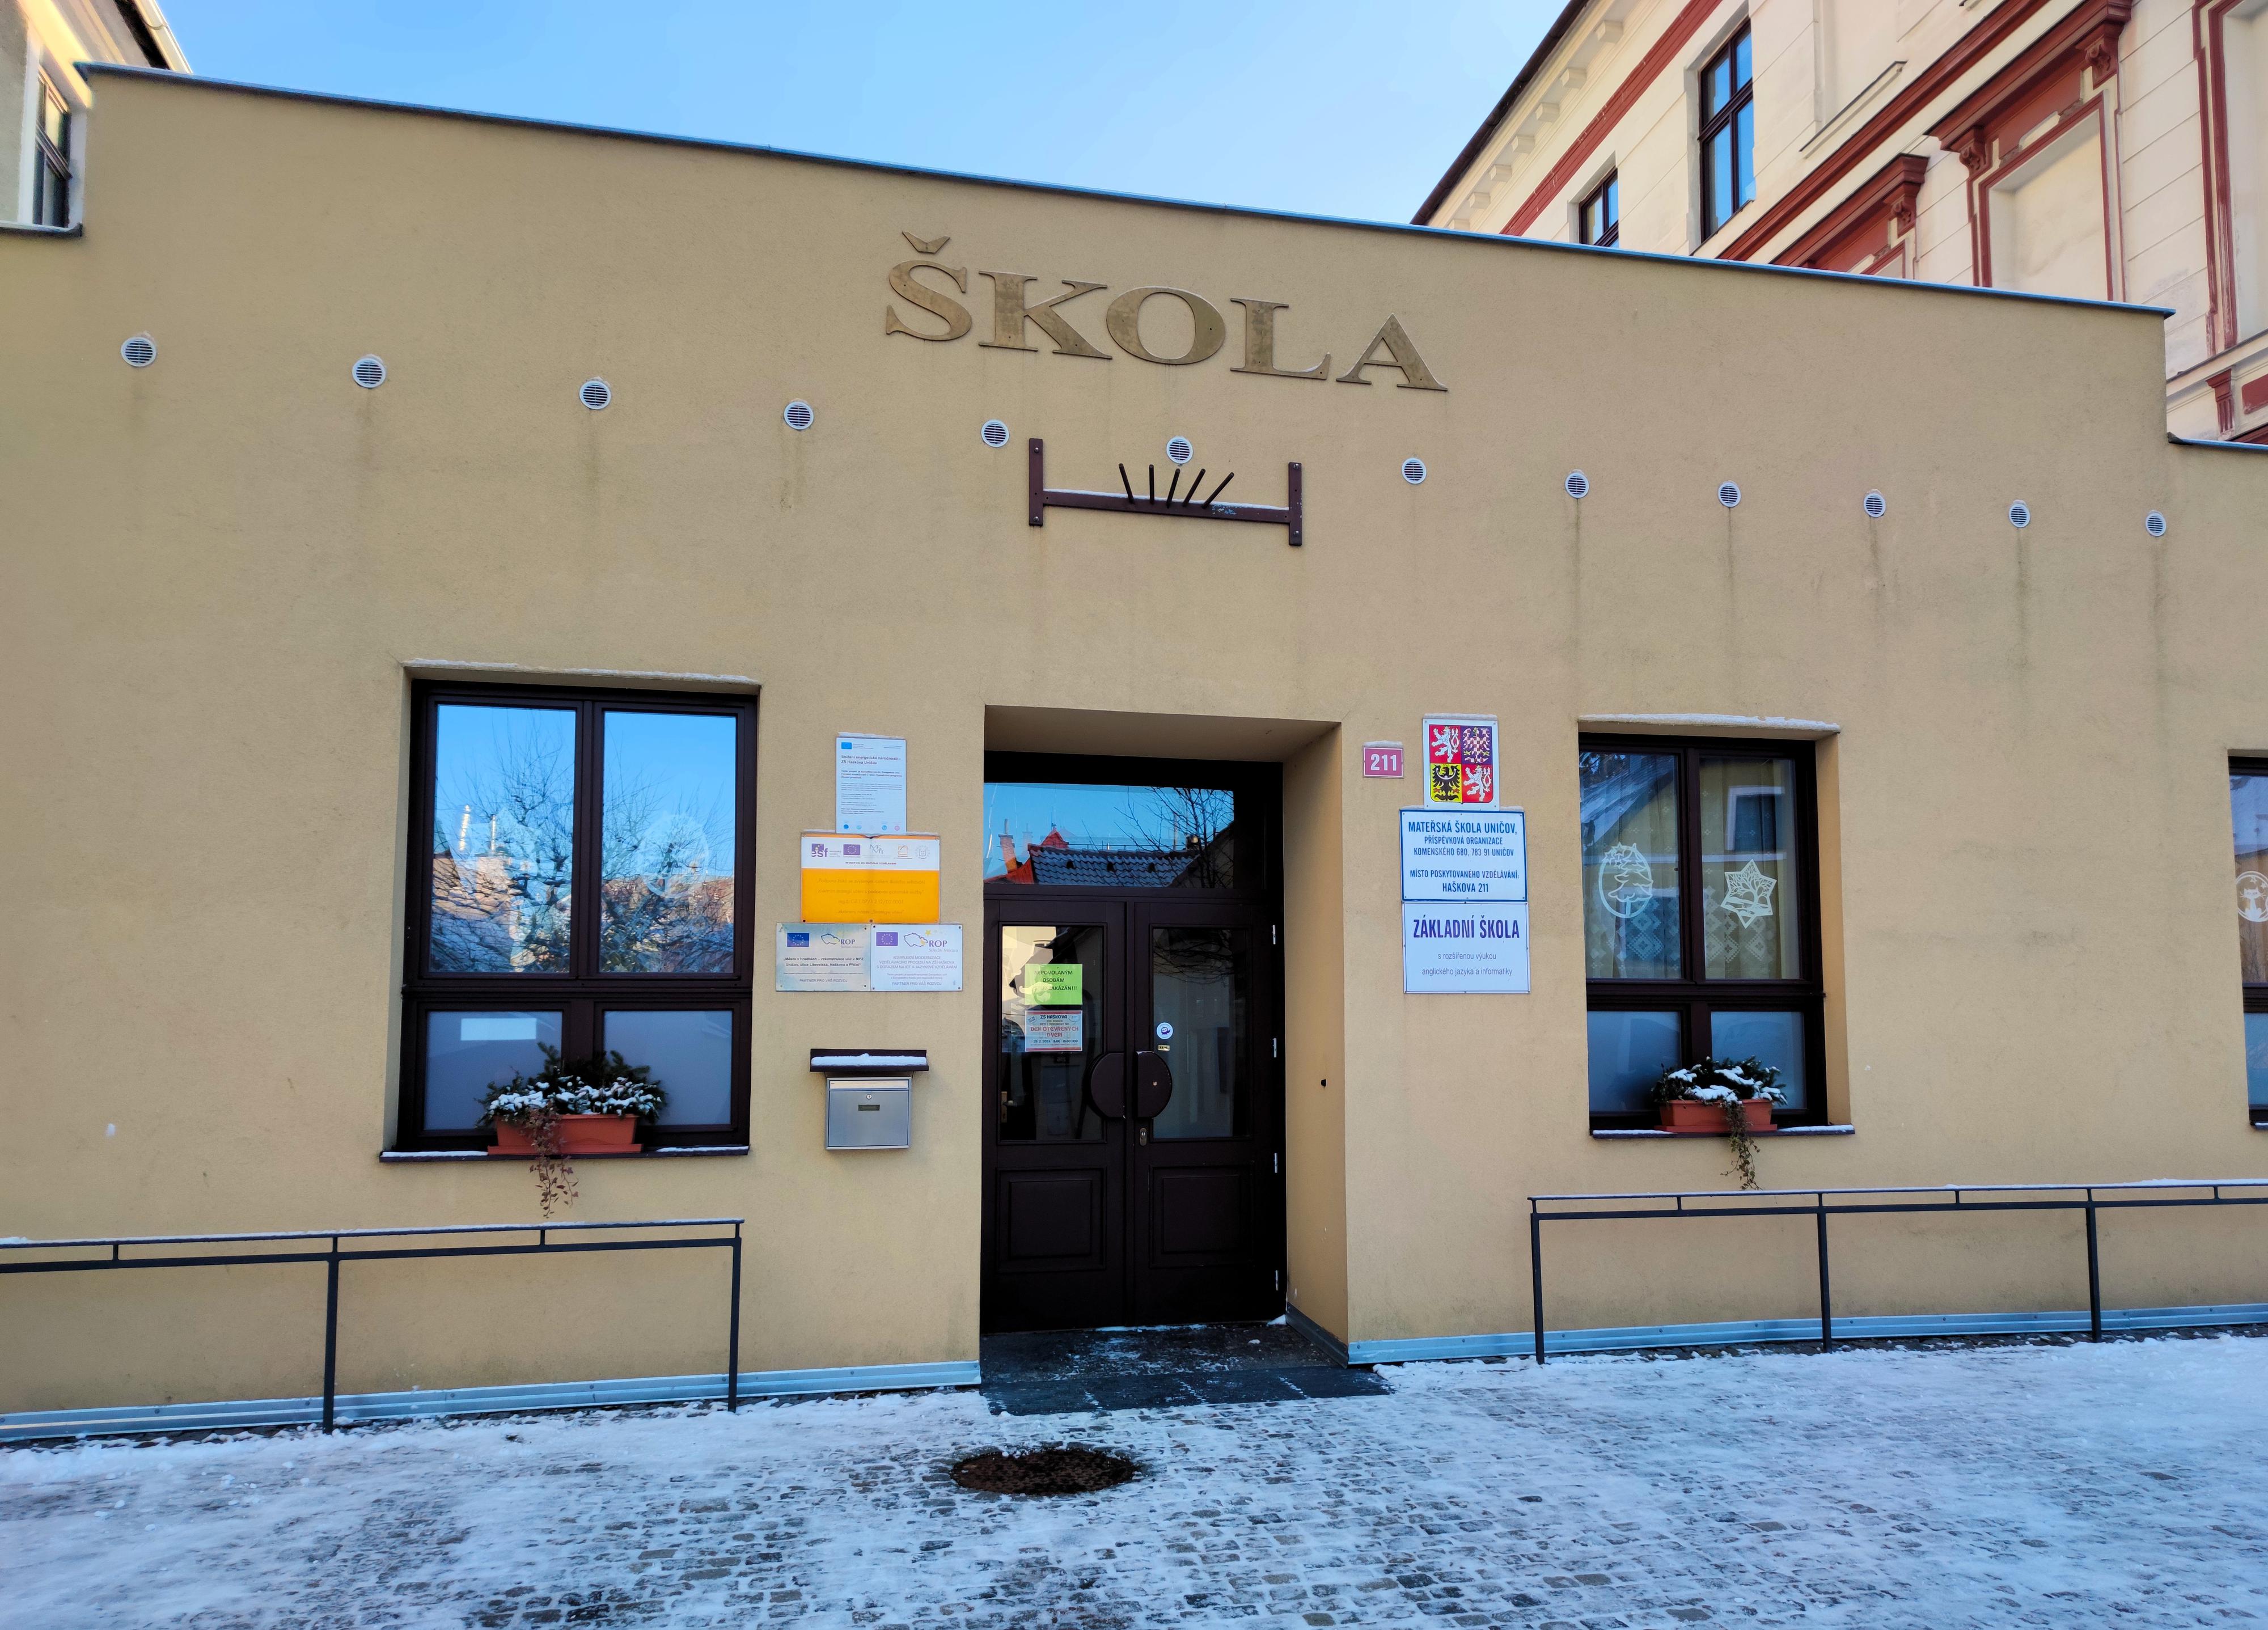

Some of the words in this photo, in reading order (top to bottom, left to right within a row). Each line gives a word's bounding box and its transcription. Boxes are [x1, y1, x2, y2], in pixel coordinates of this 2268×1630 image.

[886, 231, 1448, 392] ŠKOLA
[1370, 753, 1397, 771] 211
[1408, 820, 1452, 833] MATEŘSKÁ
[1455, 820, 1482, 833] ŠKOLA
[1484, 821, 1517, 835] UNIČOV,
[1424, 836, 1465, 844] PŘÍSPĚVKOVÁ
[1414, 846, 1454, 856] KOMENSKÉHO
[1457, 848, 1470, 857] 680,
[1410, 869, 1428, 878] MÍSTO
[1431, 869, 1480, 878] POSKYTOVANÉHO
[1482, 870, 1520, 879] VZDĚLÁVÁNÍ:
[1442, 882, 1475, 892] HAŠKOVA
[1478, 883, 1488, 892] 211
[1414, 915, 1474, 938] ZÁKLADNÍ
[1479, 915, 1520, 938] ŠKOLA
[1422, 968, 1453, 976] anglického
